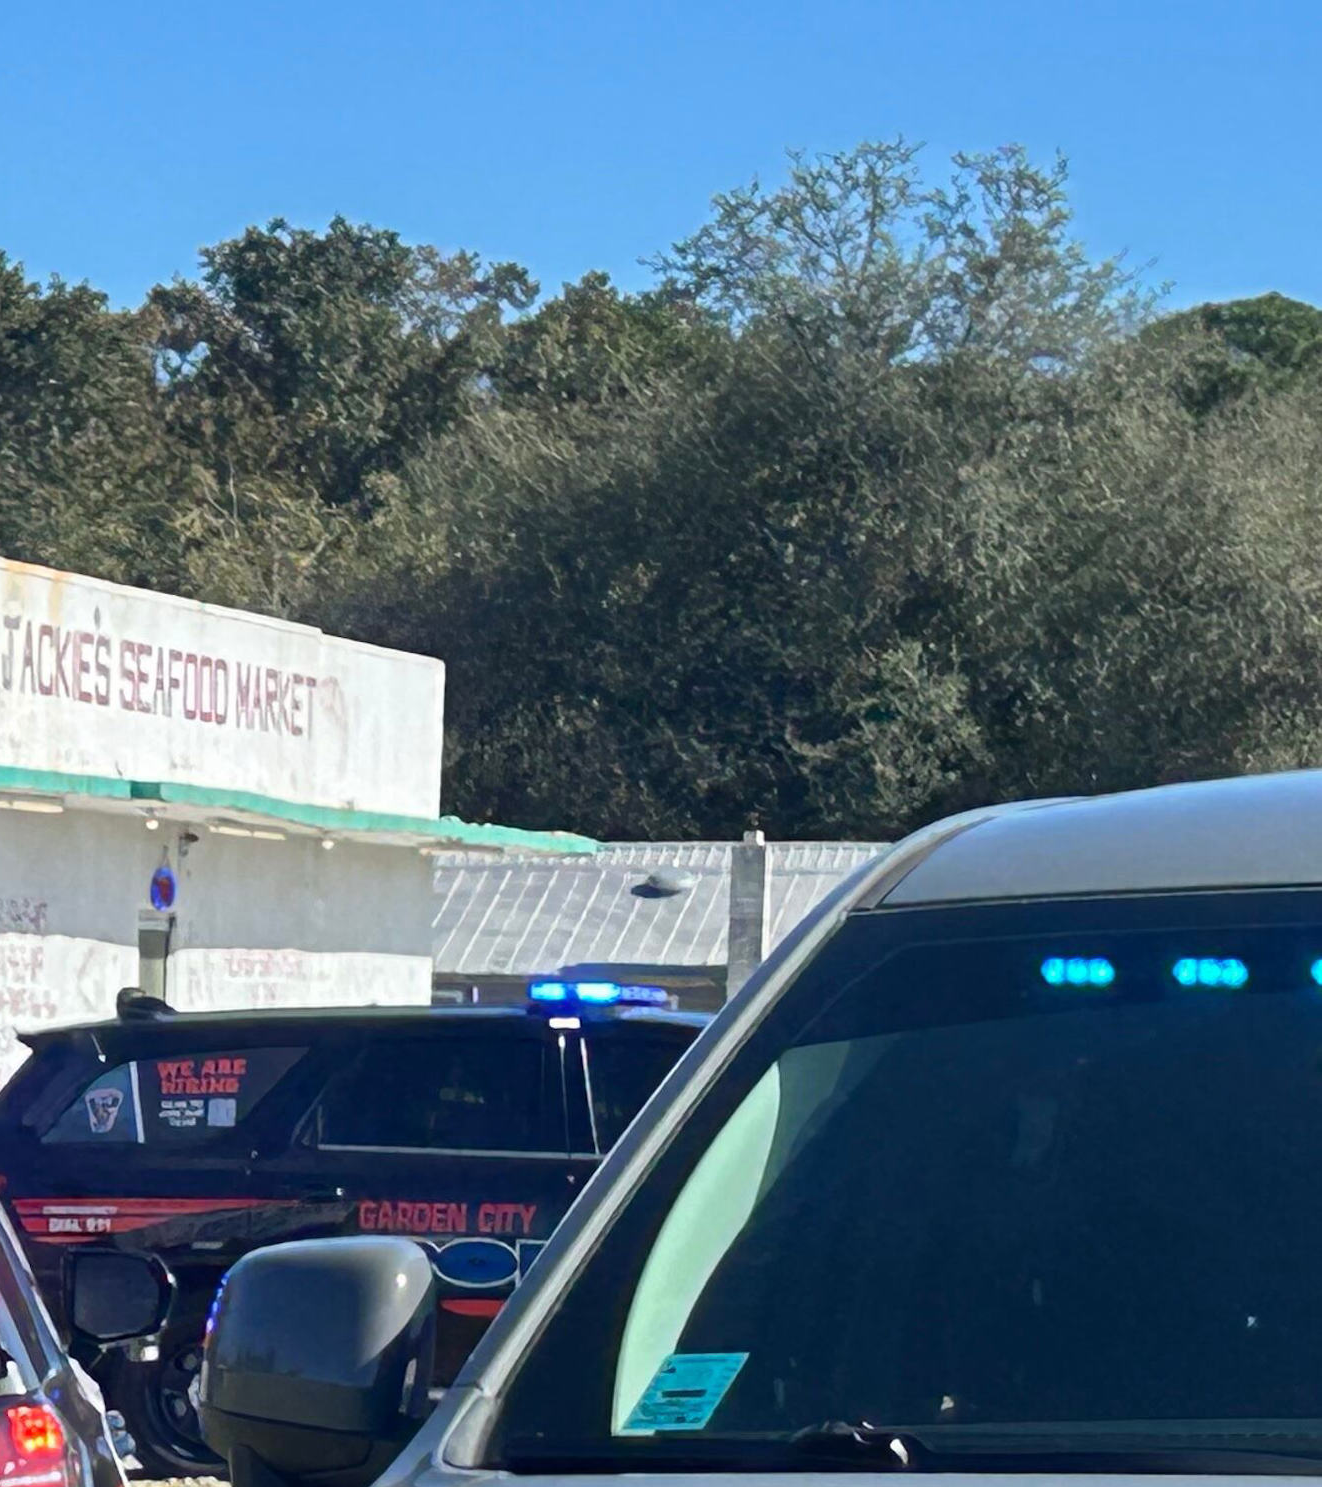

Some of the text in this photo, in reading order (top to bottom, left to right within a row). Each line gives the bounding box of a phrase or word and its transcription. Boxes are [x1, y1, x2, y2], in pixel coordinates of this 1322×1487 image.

[119, 640, 228, 726] SEAFOOD
[235, 661, 317, 739] MARKET
[359, 1200, 538, 1234] GARDEN CITY
